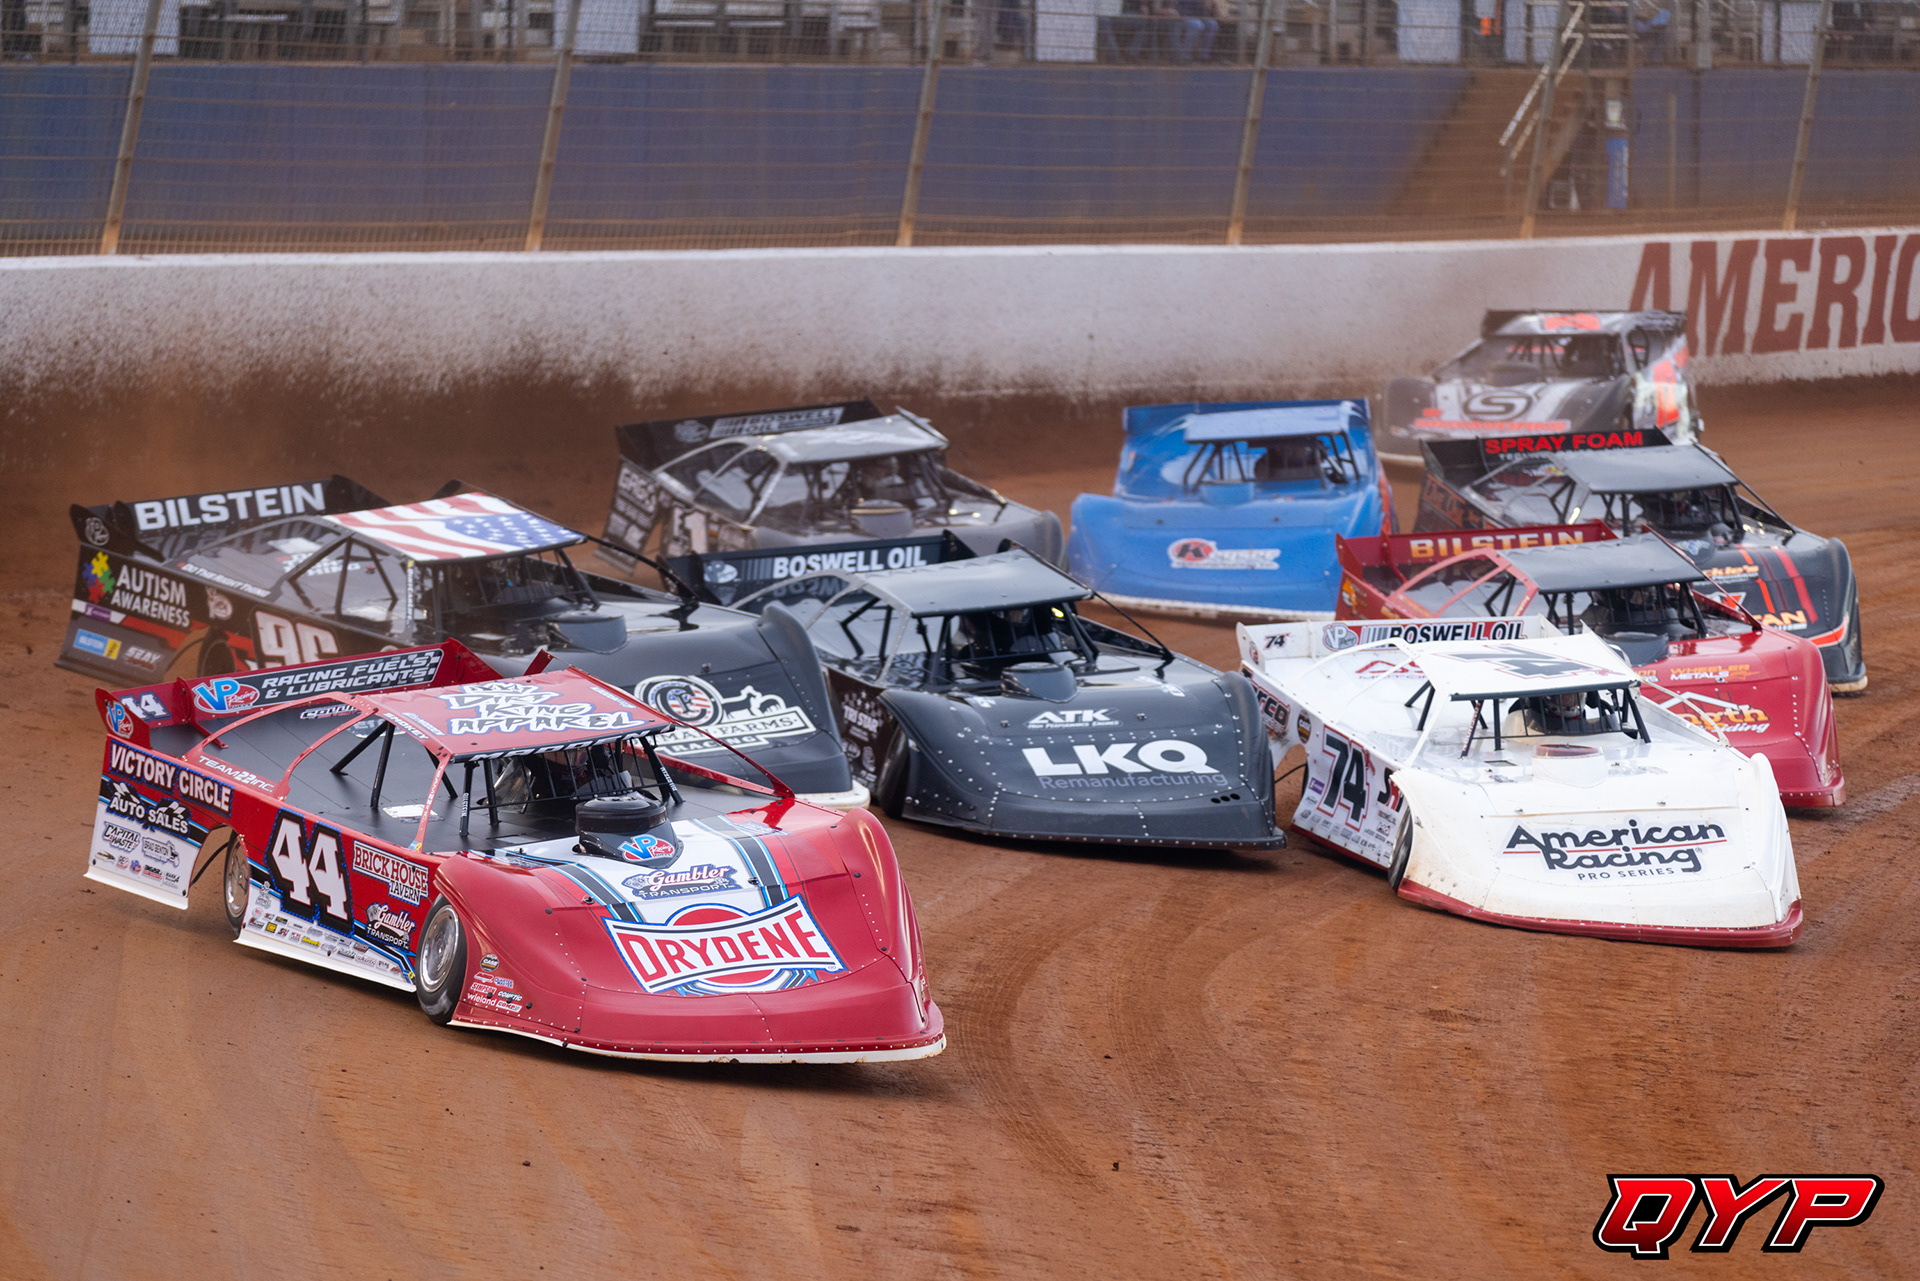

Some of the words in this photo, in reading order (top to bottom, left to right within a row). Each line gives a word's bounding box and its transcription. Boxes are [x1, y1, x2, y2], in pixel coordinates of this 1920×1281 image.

[1485, 435, 1566, 454] SPRAY
[1572, 431, 1643, 450] FOAM
[134, 482, 326, 531] BILSTEIN
[1409, 531, 1584, 558] BILSTEIN
[773, 550, 885, 579] BOSWELL
[887, 546, 928, 570] OIL
[116, 564, 187, 607] AUTISM
[110, 589, 190, 628] AWARENESS
[1265, 634, 1287, 649] 74
[1389, 623, 1488, 646] BOSWELL
[1492, 622, 1525, 641] OIL
[261, 668, 350, 689] RACING
[353, 653, 432, 676] FUELS
[1670, 664, 1750, 675] WHEELER
[1670, 670, 1730, 681] METALS
[195, 679, 241, 712] VP
[264, 688, 281, 700] &
[284, 670, 429, 696] LUBRICANTS
[107, 701, 125, 733] VP
[382, 712, 430, 739] SMOKEY
[456, 713, 640, 732] APPAREL
[719, 715, 794, 736] FARMS
[1028, 708, 1112, 724] ATK
[673, 734, 758, 752] RACNG
[1022, 739, 1220, 776] LKQ
[110, 743, 176, 790] VICTORY
[178, 768, 233, 814] CIRCLE
[1038, 772, 1229, 790] Remanufacturing
[1325, 733, 1368, 823] 74
[108, 793, 146, 820] AUTO
[147, 809, 190, 835] SALES
[103, 825, 140, 843] CAPITAL
[111, 837, 134, 850] WASTE
[630, 835, 658, 860] VP
[1505, 818, 1726, 850] American
[271, 819, 350, 921] 44
[354, 846, 390, 878] BRICK
[390, 862, 428, 893] HOUSE
[1541, 844, 1703, 873] Racing
[648, 865, 731, 892] Gambler
[1577, 871, 1610, 881] PRO
[1617, 866, 1675, 879] SERIES
[389, 880, 421, 903] TAVERN
[637, 884, 731, 899] TRANSPORT
[373, 904, 417, 934] Gambler
[366, 924, 410, 949] TRANSPORT
[616, 909, 831, 984] DRYDENE
[467, 992, 497, 1006] wieland
